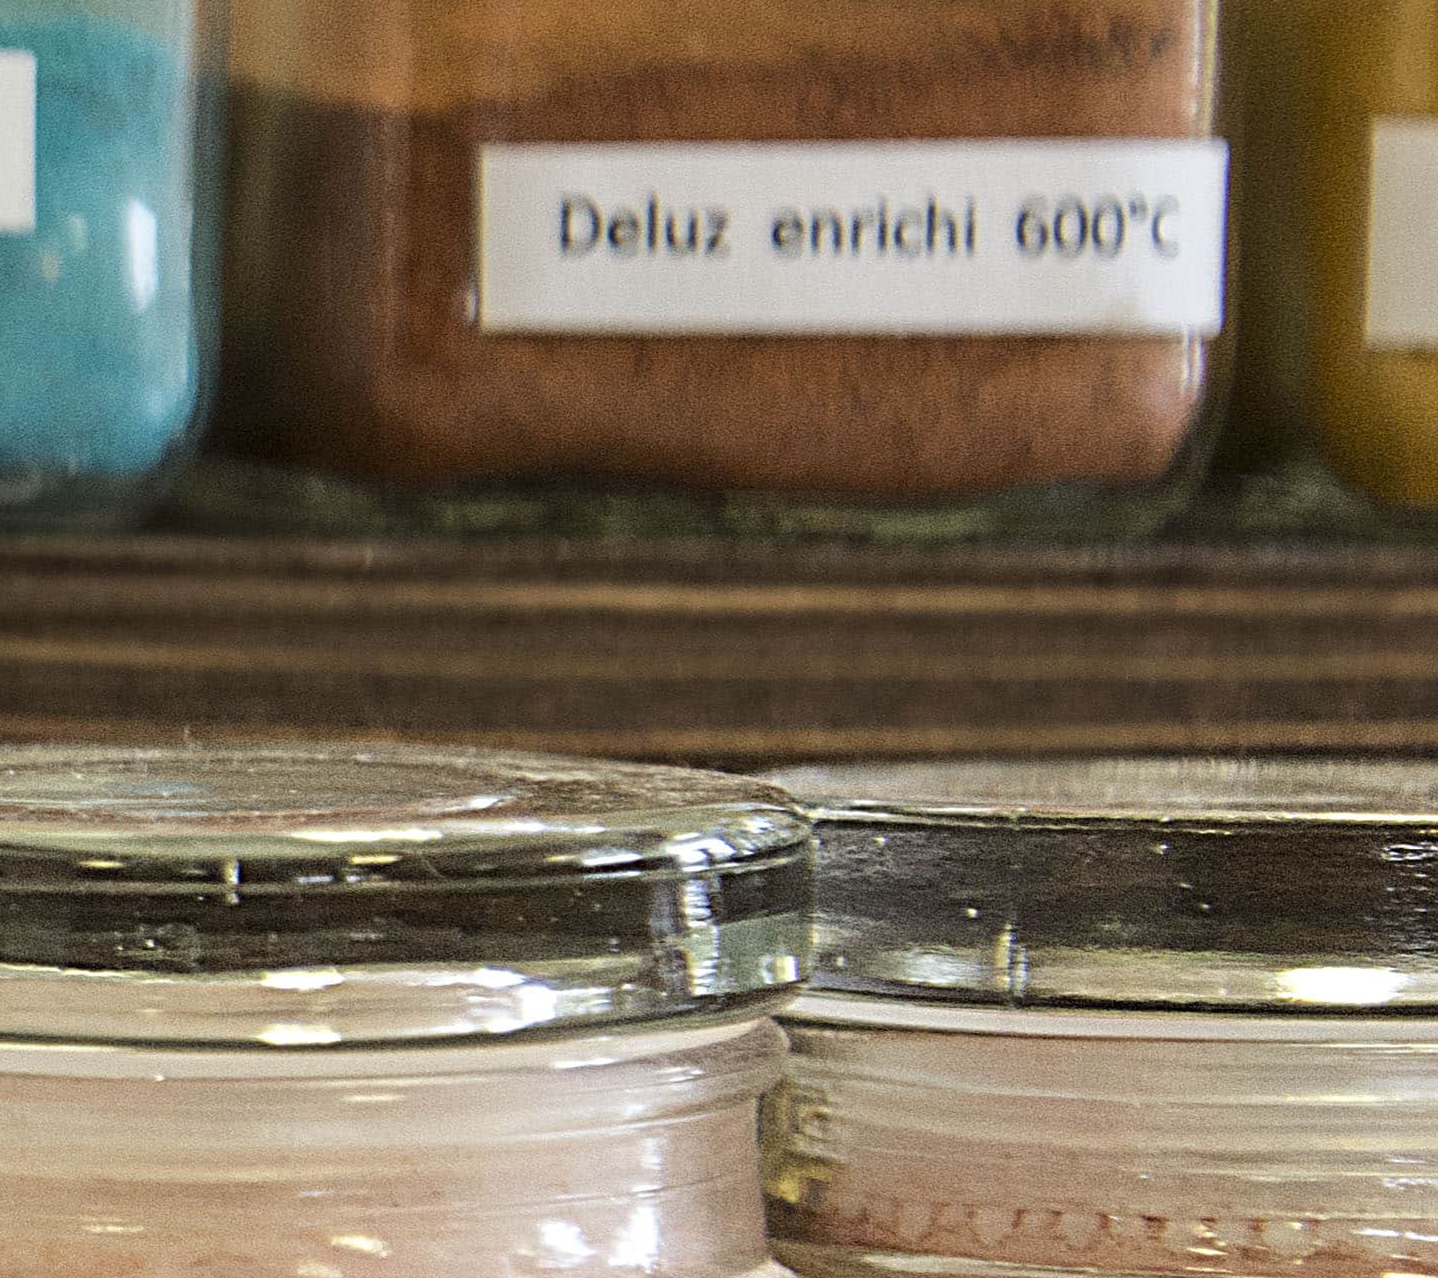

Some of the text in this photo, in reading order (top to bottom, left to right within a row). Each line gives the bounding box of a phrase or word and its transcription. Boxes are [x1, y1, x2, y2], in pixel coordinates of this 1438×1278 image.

[559, 194, 1181, 261] Deluz enrichi 600°C
